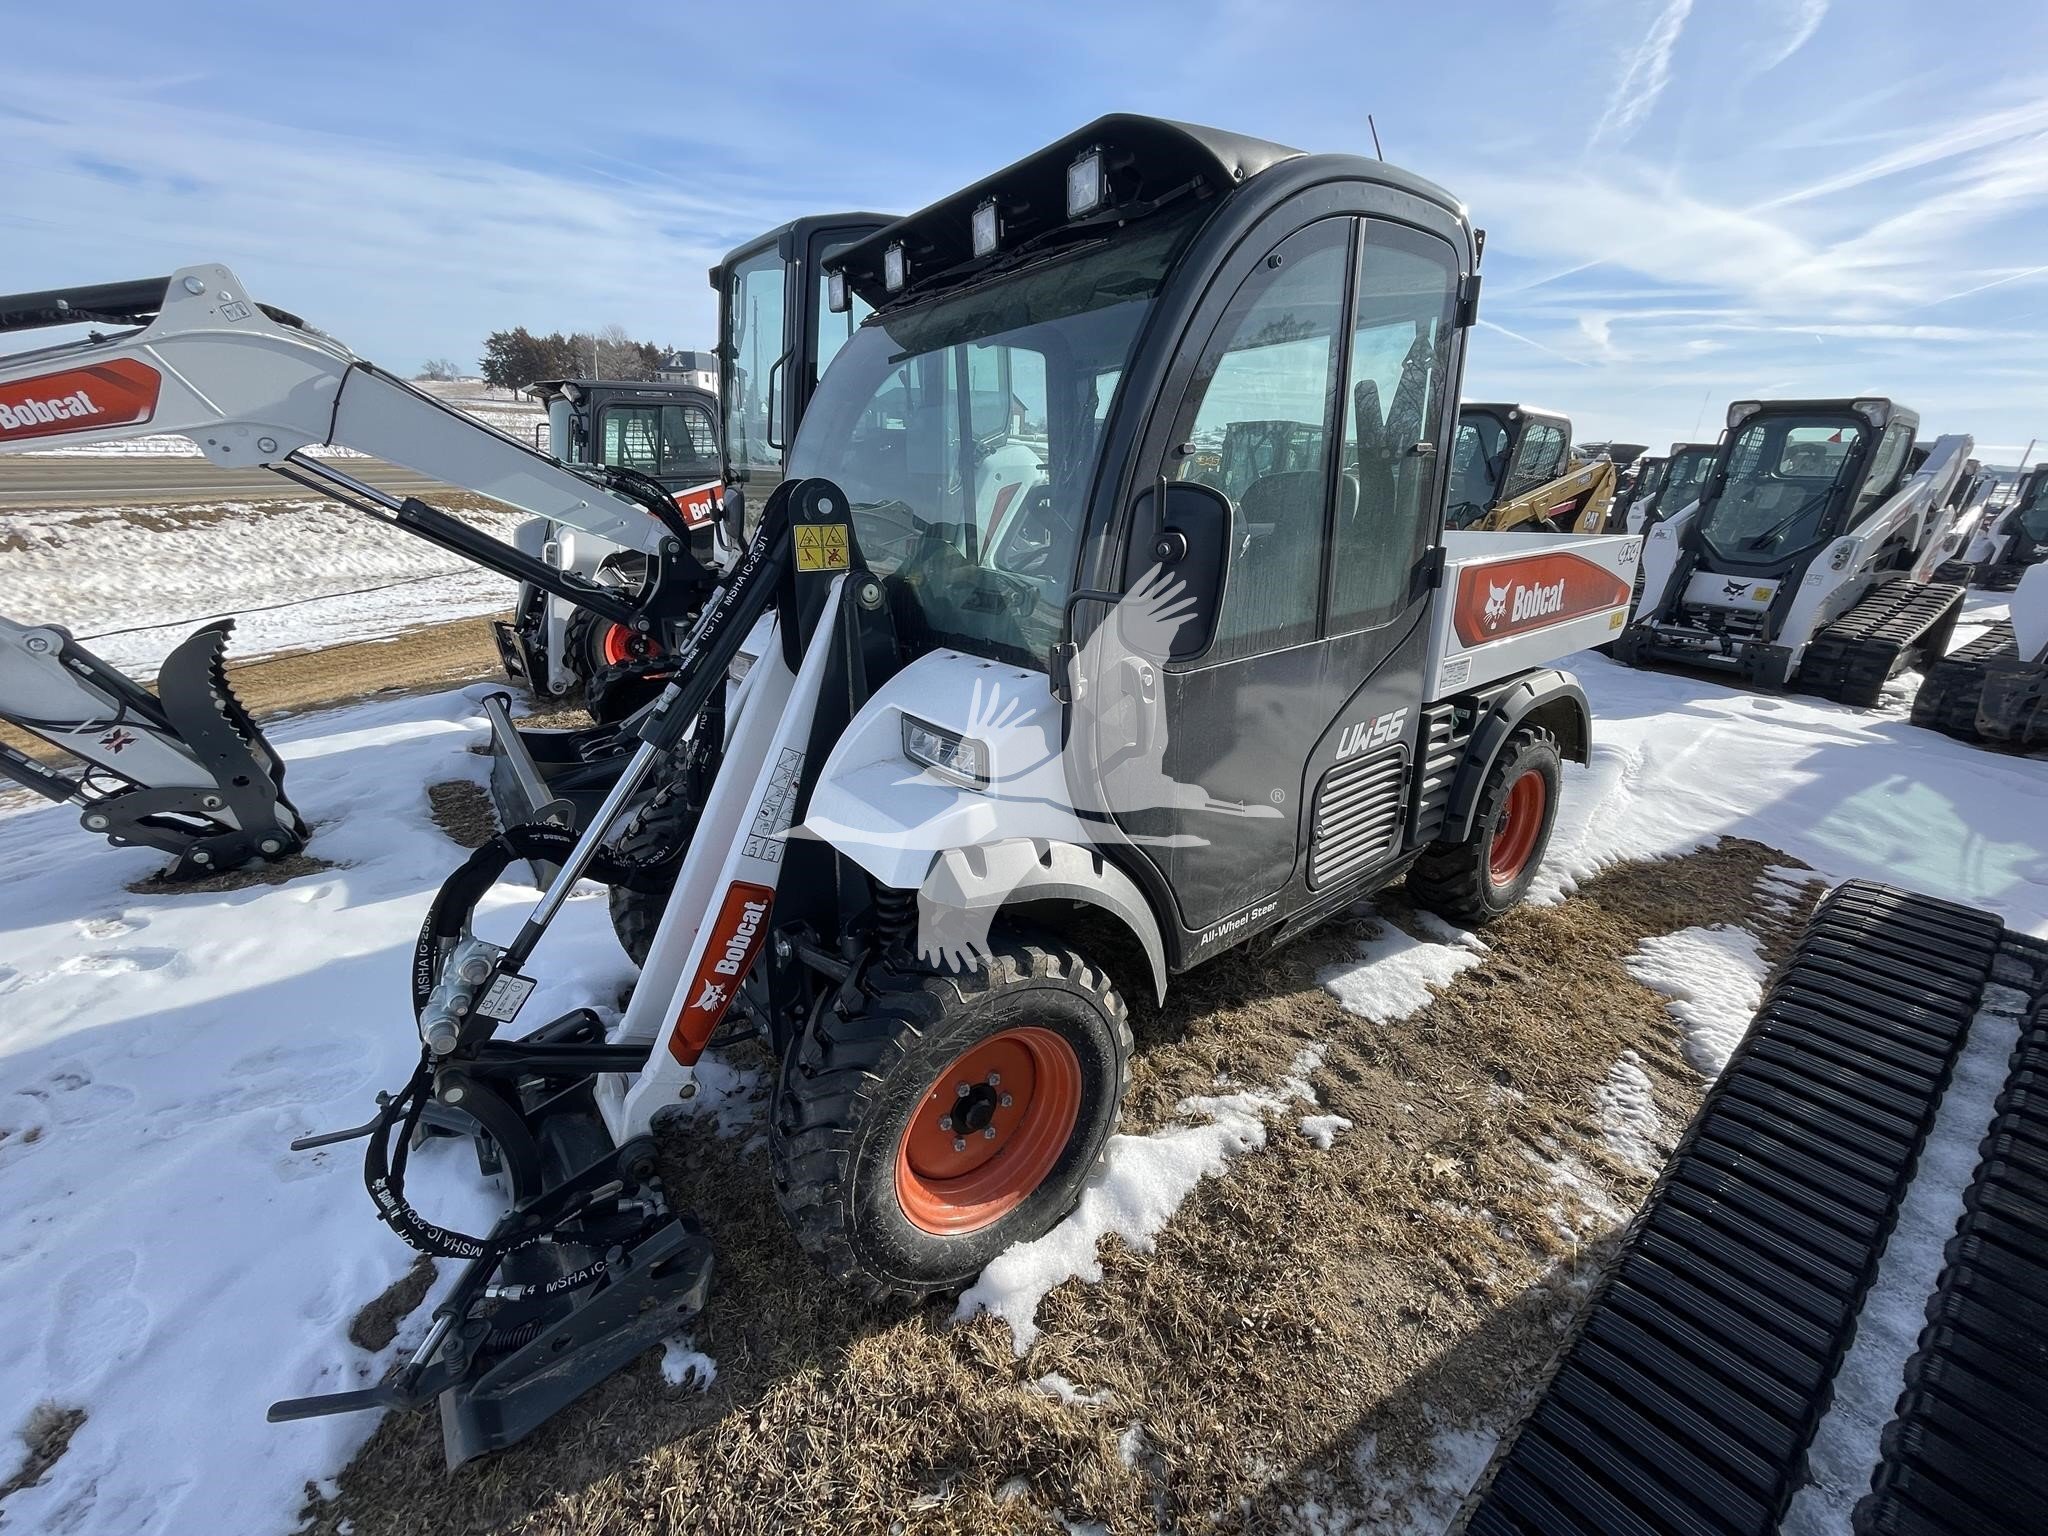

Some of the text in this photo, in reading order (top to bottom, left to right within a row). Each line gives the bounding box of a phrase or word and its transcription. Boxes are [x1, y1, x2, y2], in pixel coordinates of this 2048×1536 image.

[0, 390, 99, 430] Bobcat
[724, 574, 747, 606] MSHA
[1511, 578, 1565, 623] Bobcat
[714, 901, 767, 976] Bobcat
[1200, 901, 1278, 947] All-Wheel Steer
[418, 959, 431, 995] MSHA
[444, 1235, 484, 1258] MSHA
[546, 1270, 588, 1294] MSHA
